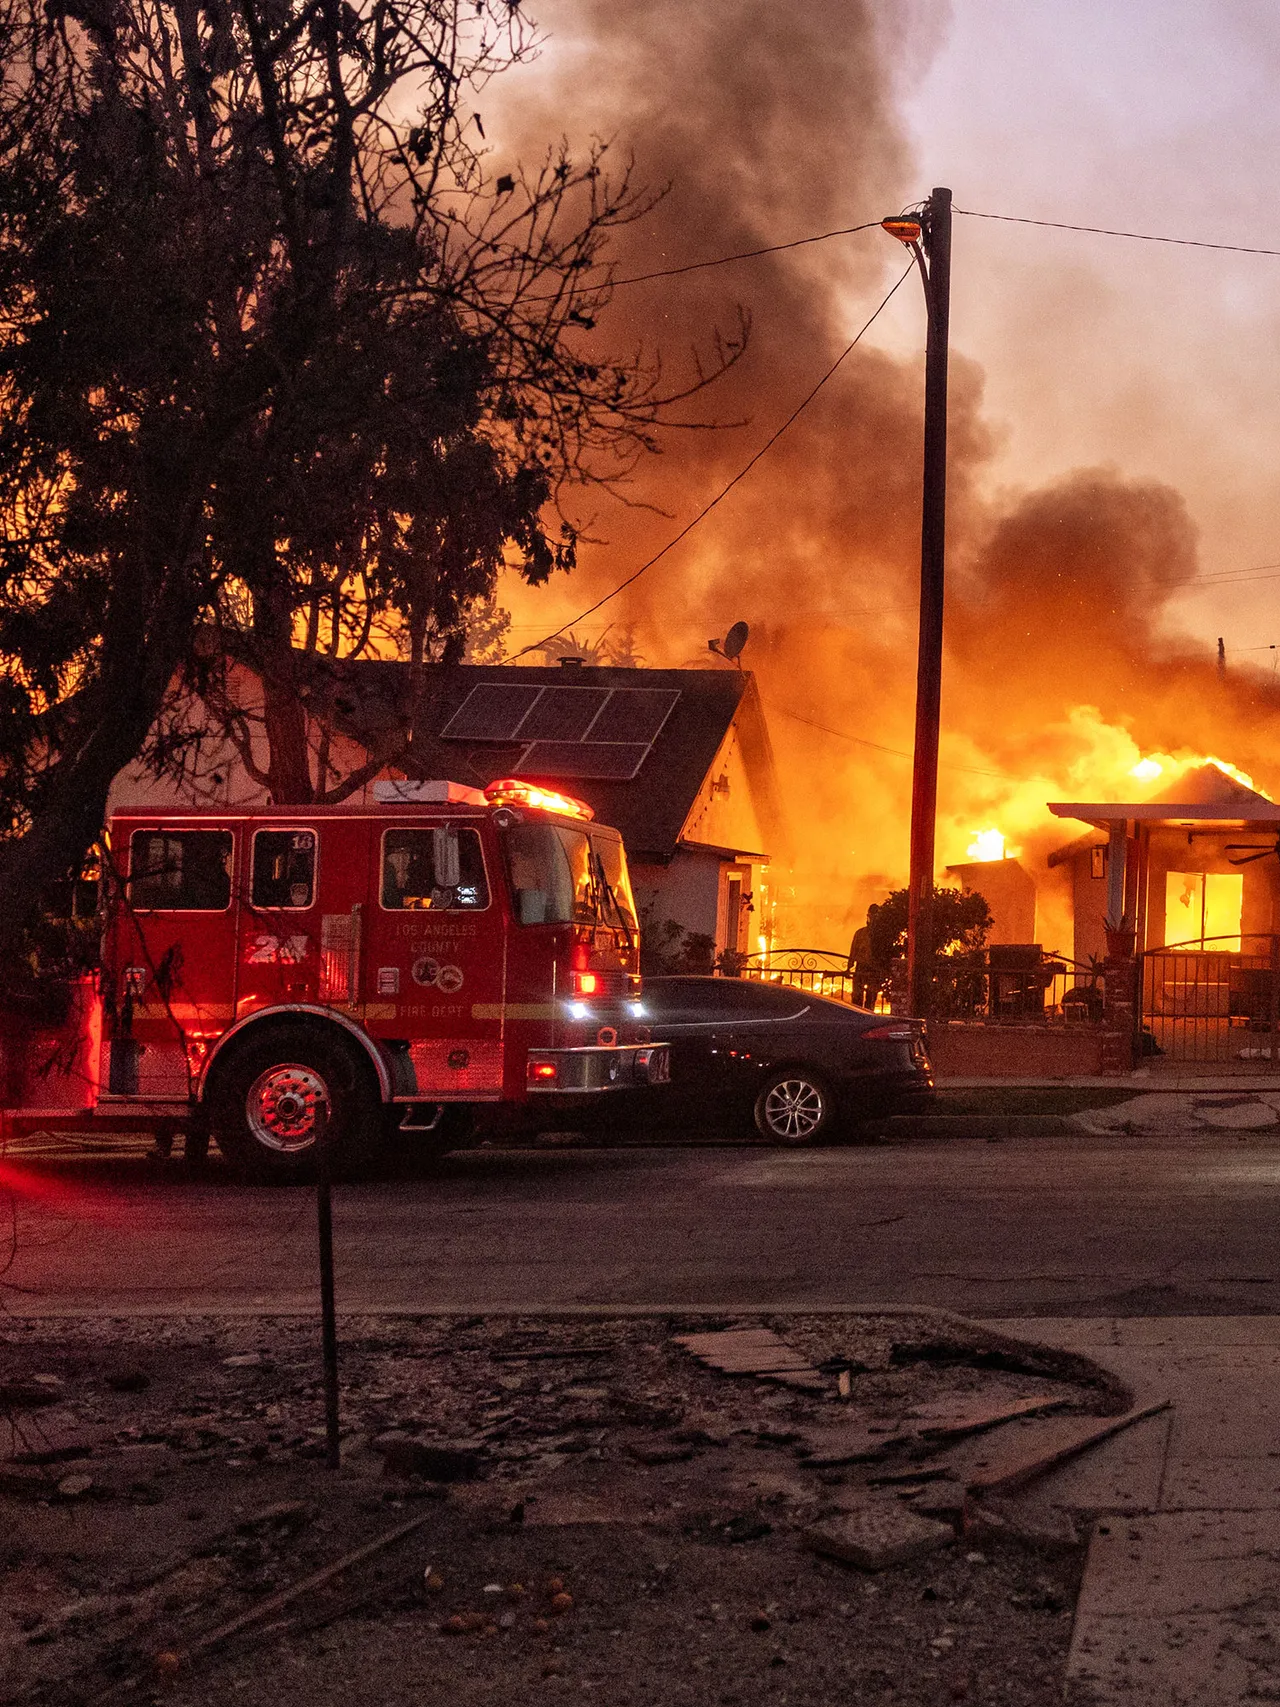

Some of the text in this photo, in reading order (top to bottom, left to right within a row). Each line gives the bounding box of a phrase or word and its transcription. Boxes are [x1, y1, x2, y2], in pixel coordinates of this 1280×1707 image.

[395, 924, 476, 936] LOS ANGELES
[410, 941, 459, 953] COUNTY
[399, 1005, 426, 1018] FIRE
